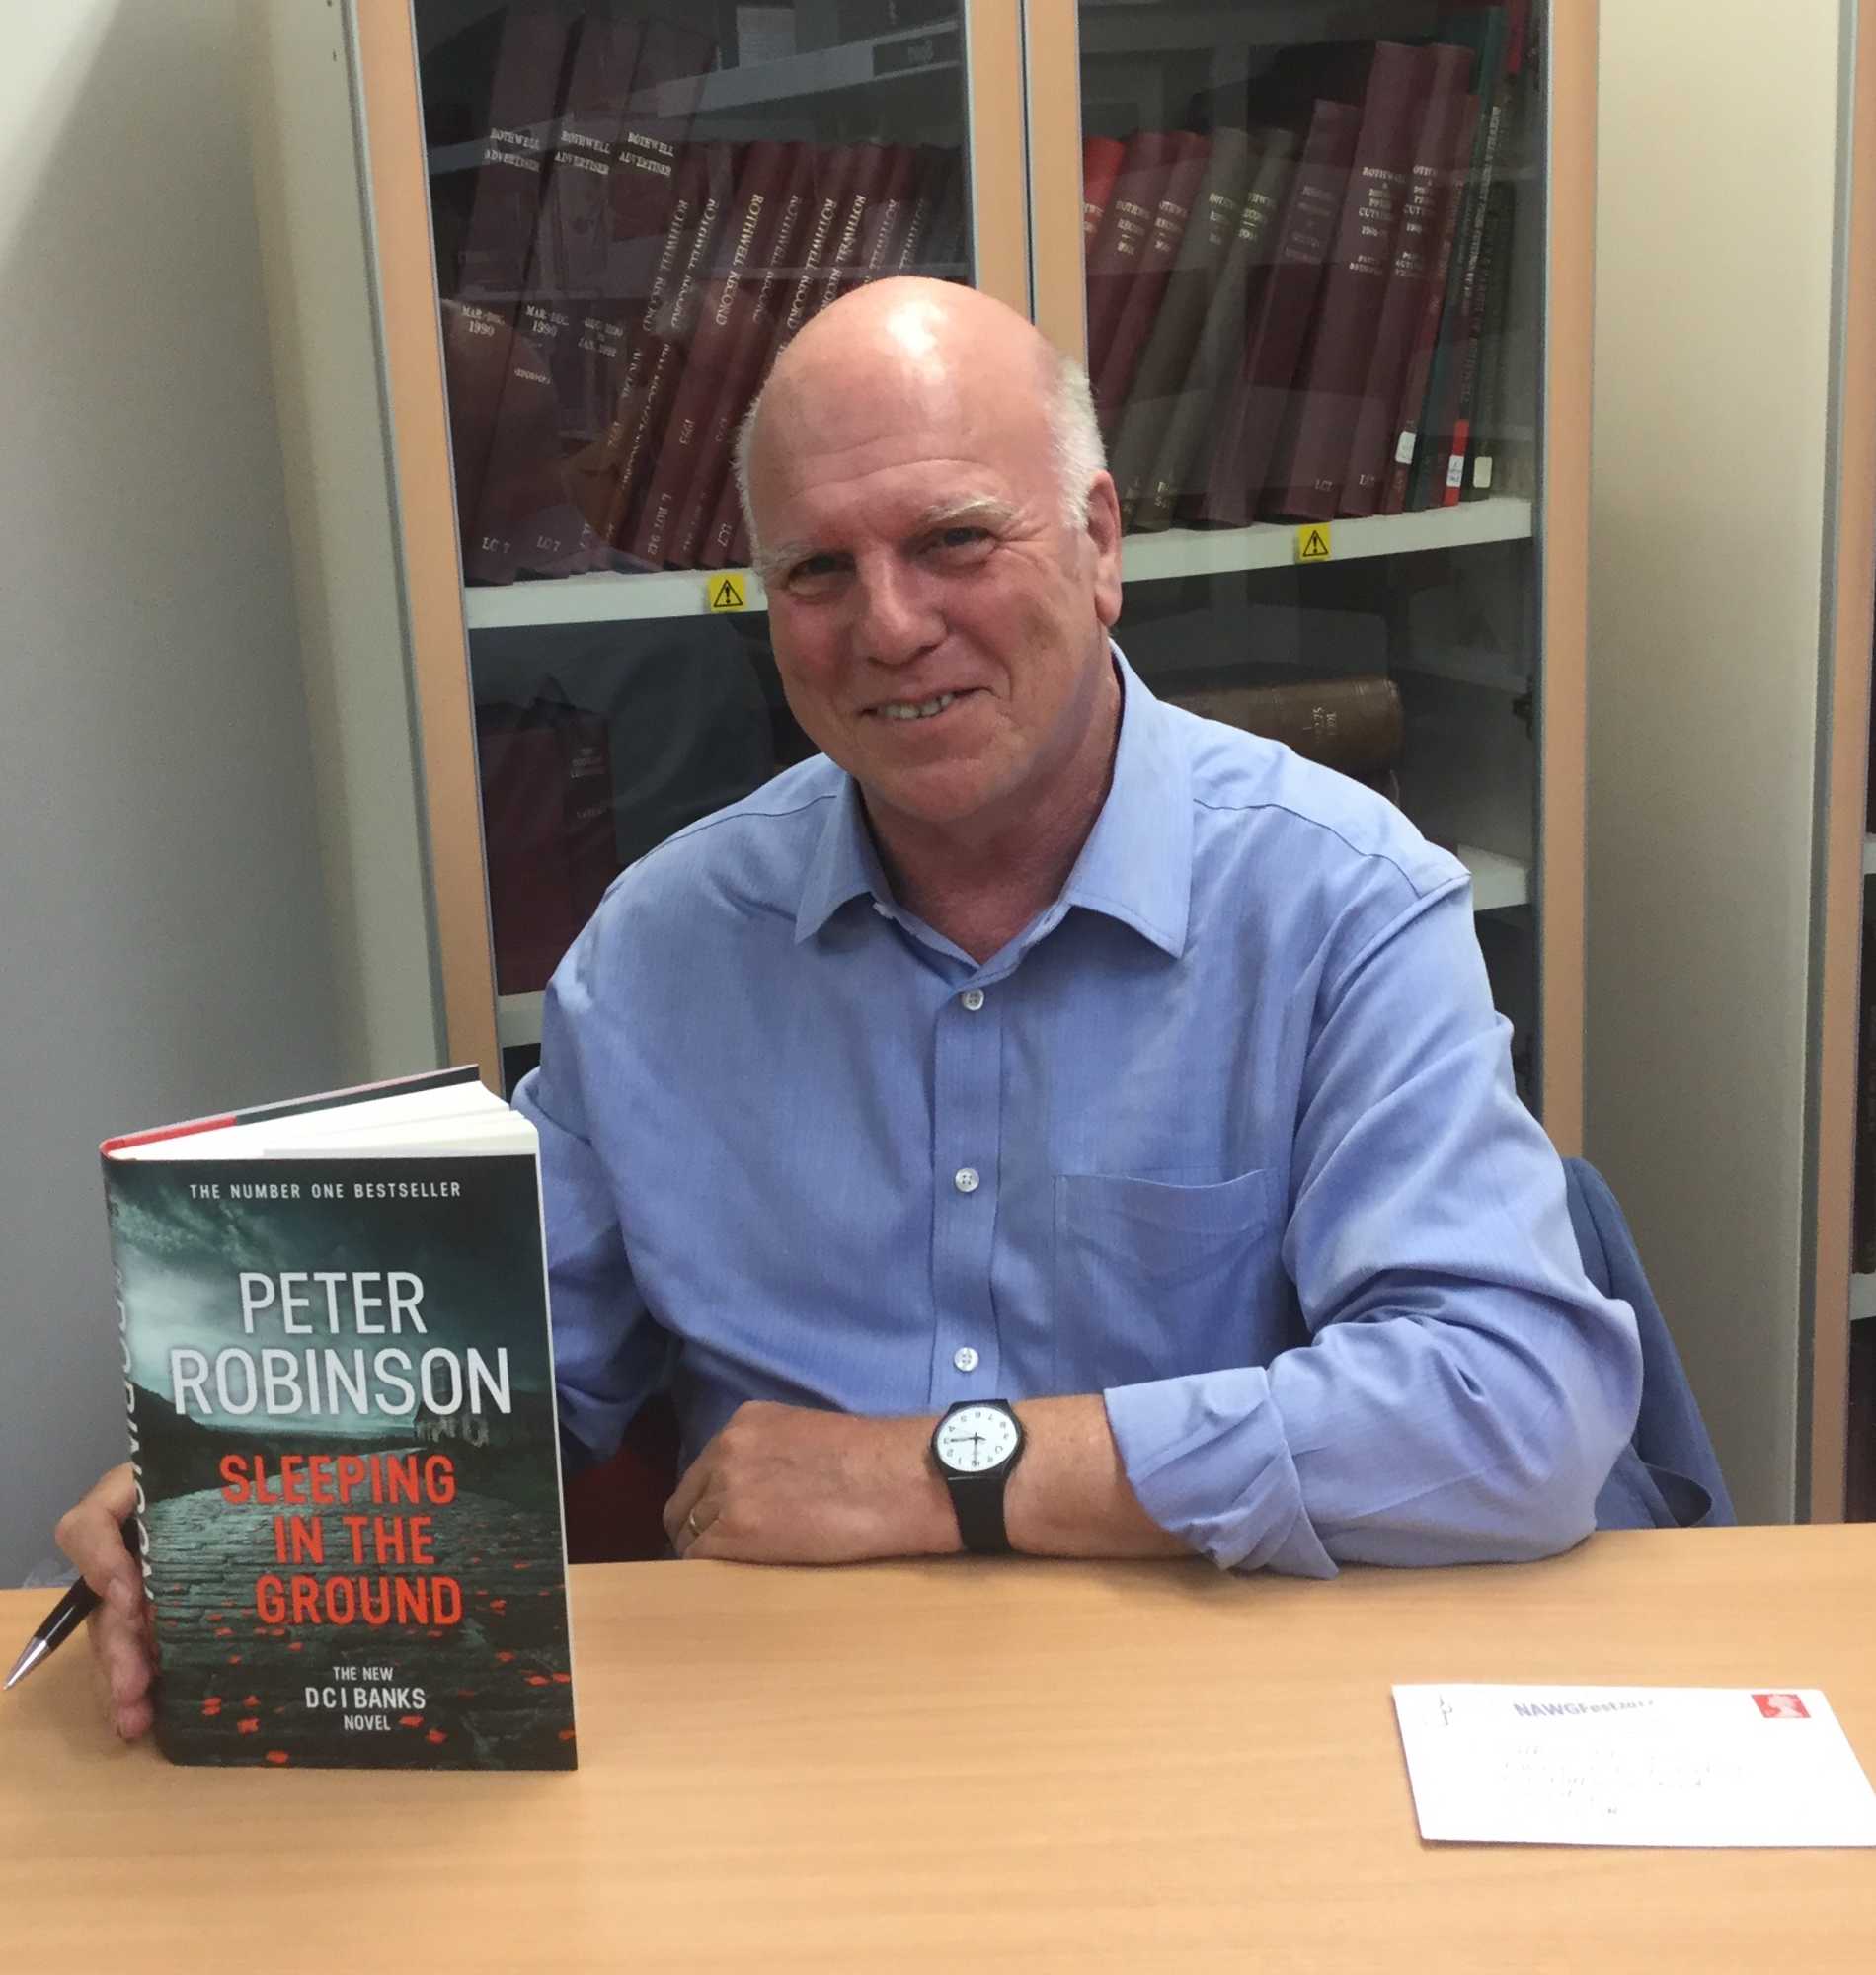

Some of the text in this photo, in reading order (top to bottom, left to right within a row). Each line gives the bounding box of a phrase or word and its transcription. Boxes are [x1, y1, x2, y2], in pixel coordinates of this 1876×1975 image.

[627, 131, 674, 157] ROTHWELL
[836, 194, 867, 263] ROTHWELL
[716, 194, 764, 326] ROTHWELL RECORD
[787, 198, 837, 329] ROTHWELL RECORD
[190, 1182, 461, 1199] THE NUMBER ONE BESTSELLER
[239, 1271, 427, 1334] PETER
[171, 1347, 511, 1415] ROBINSON
[219, 1453, 457, 1505] SLEEPING
[274, 1515, 434, 1564] IN THE
[256, 1574, 463, 1625] GROUND
[333, 1666, 393, 1681] THE NEW
[353, 1687, 426, 1709] BANKS
[344, 1714, 391, 1731] NOVEL
